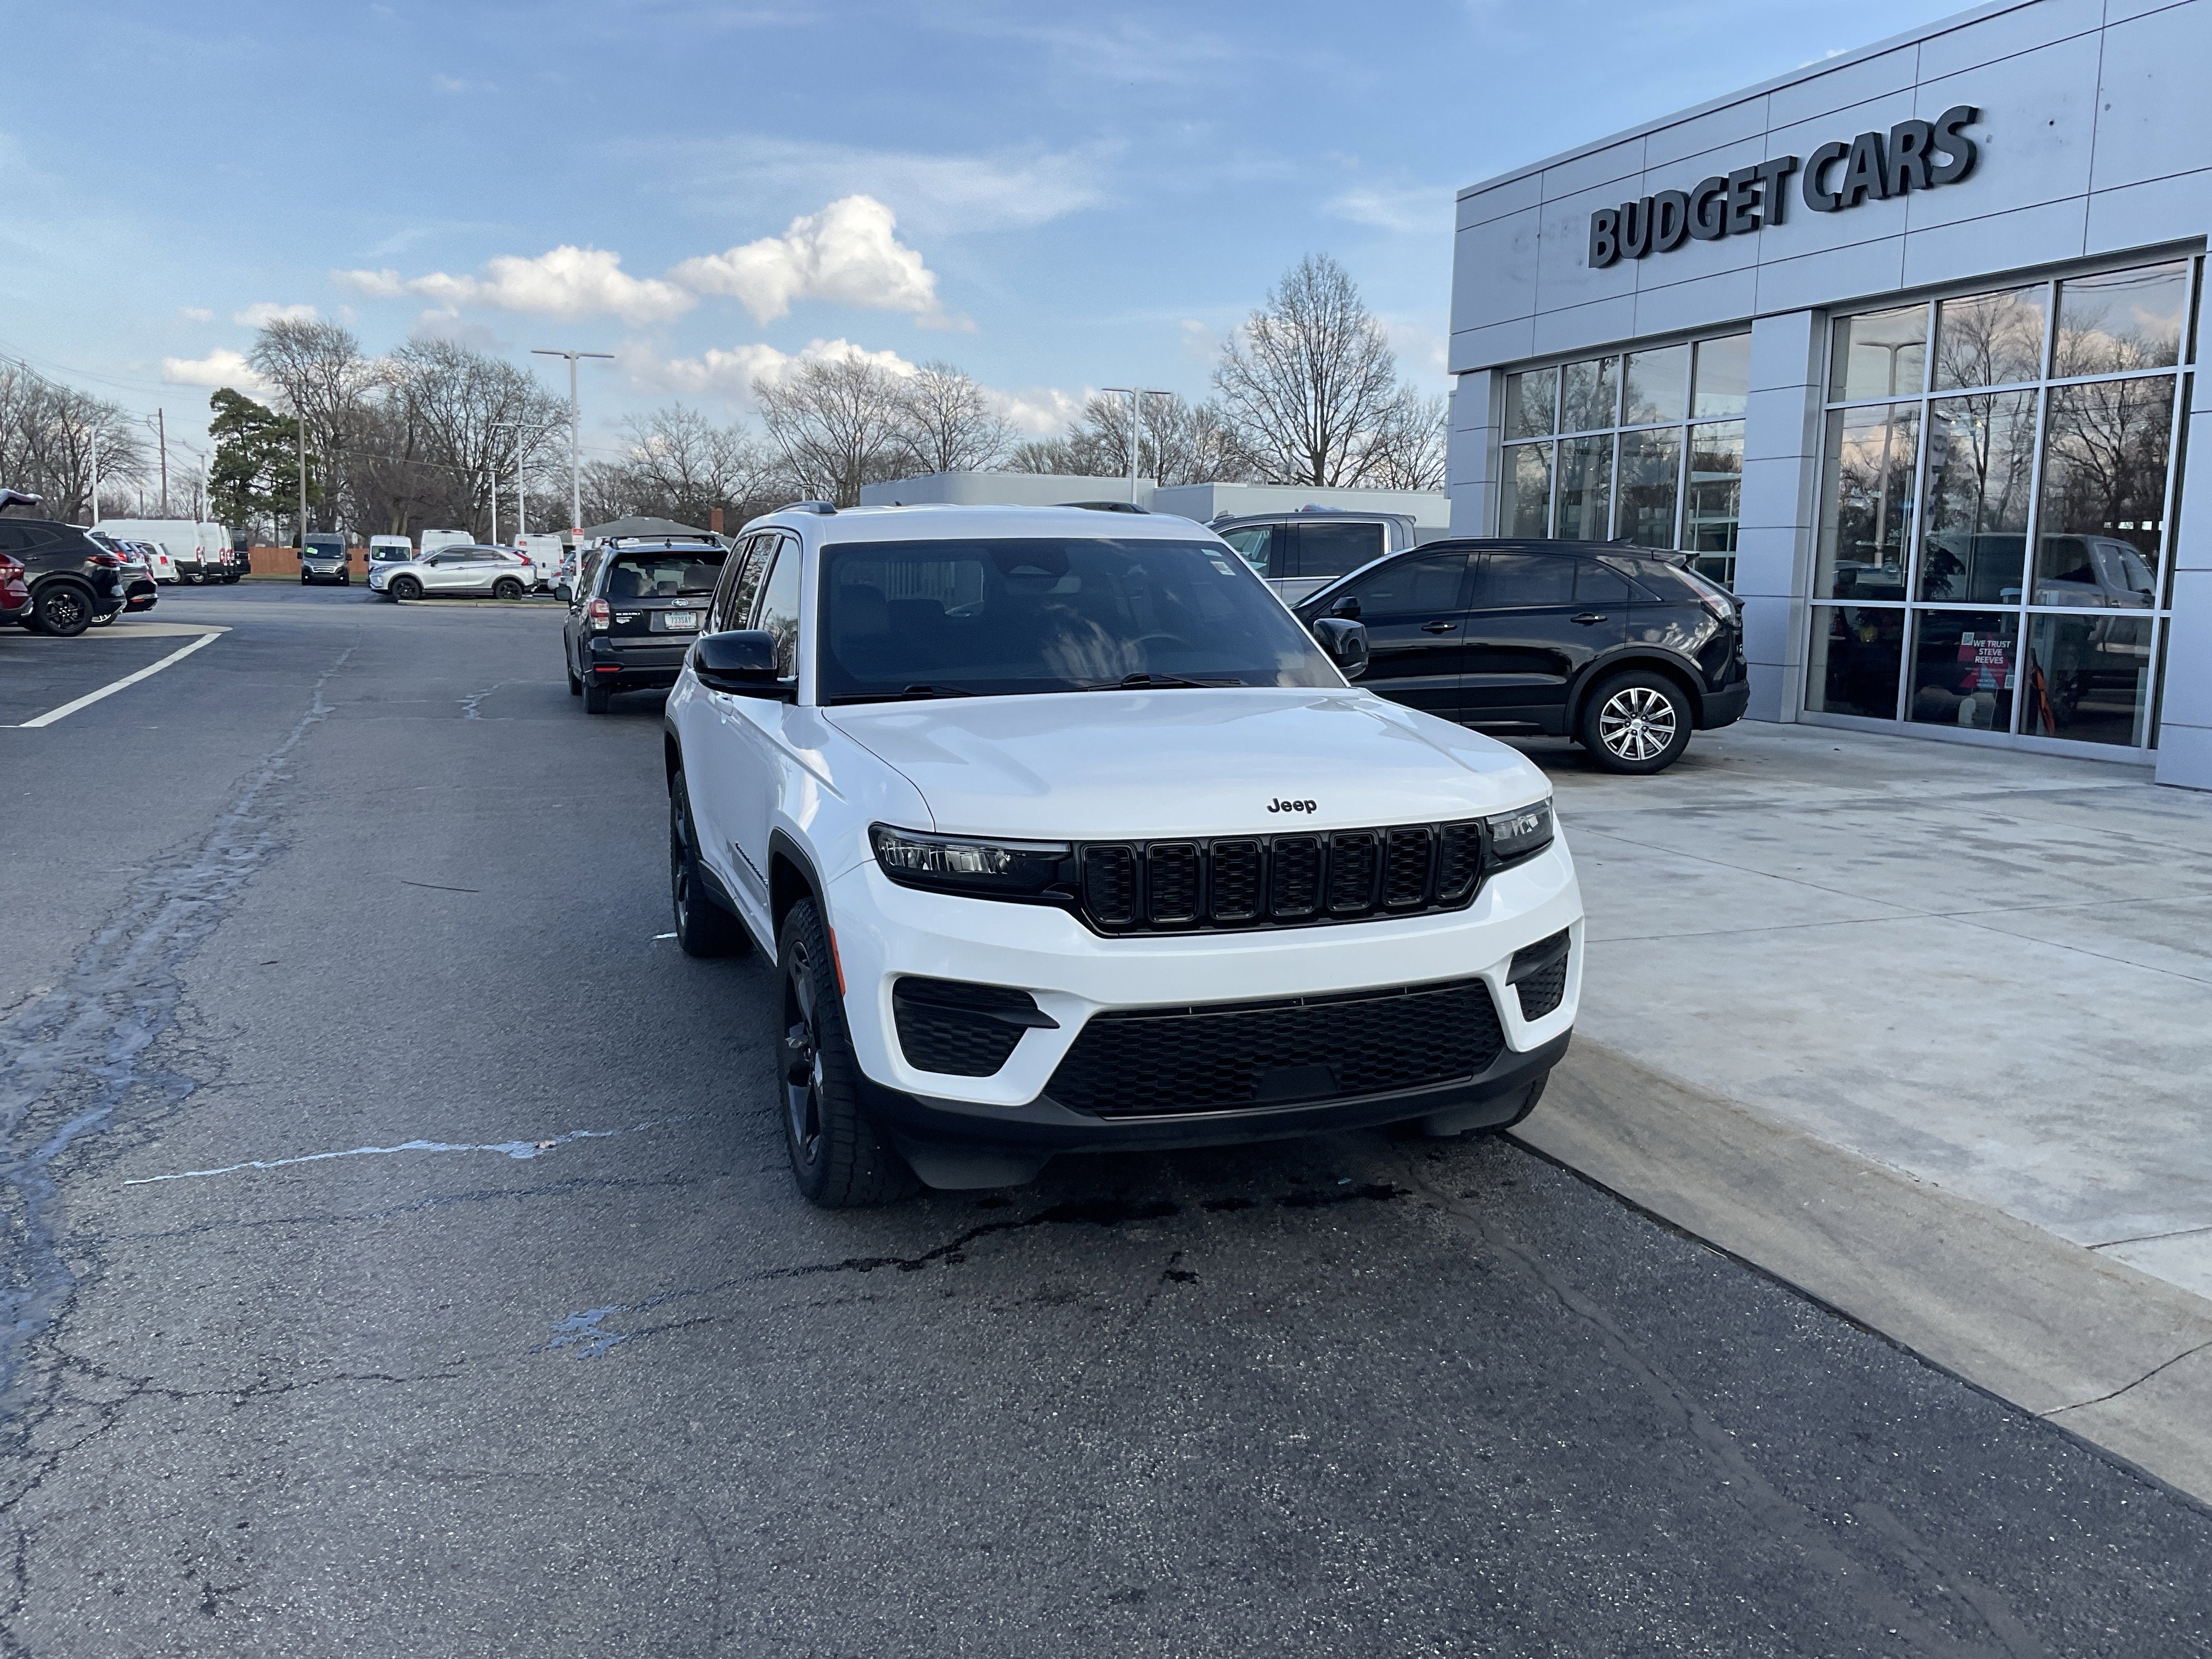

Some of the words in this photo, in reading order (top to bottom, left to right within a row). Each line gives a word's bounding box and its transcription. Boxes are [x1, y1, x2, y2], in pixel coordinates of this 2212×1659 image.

[1589, 156, 1797, 268] BUDGET
[1803, 105, 1979, 212] CARS
[1267, 798, 1317, 814] Jeep
